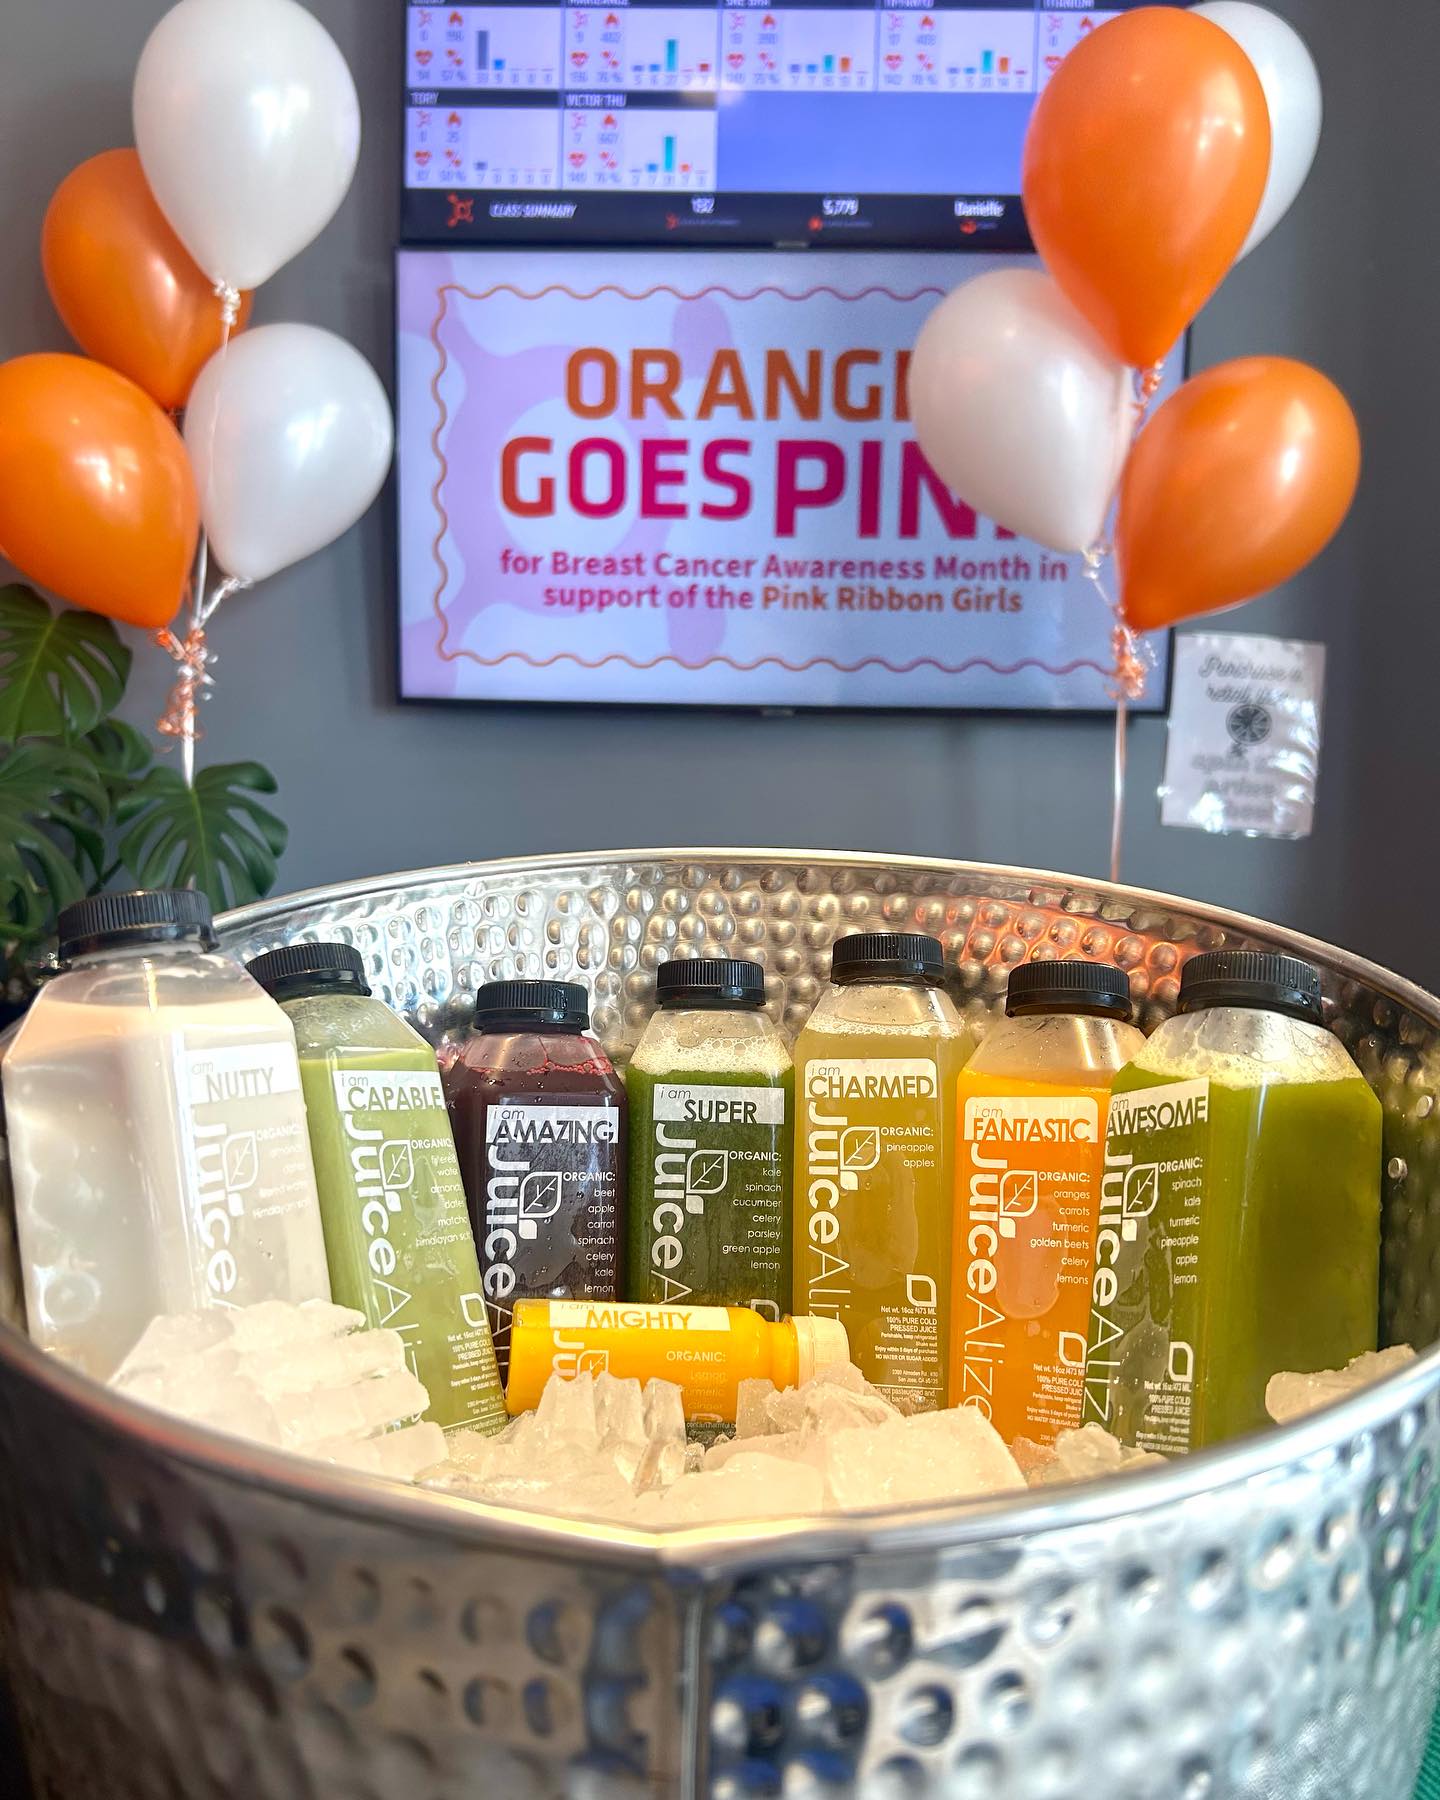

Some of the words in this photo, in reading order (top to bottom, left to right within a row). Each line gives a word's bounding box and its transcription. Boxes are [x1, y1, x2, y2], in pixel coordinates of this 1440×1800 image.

[501, 436, 752, 521] GOES
[774, 440, 1016, 539] PIN
[500, 549, 542, 575] for
[551, 551, 645, 577] Breast
[655, 553, 755, 579] Cancer
[763, 554, 924, 580] Awareness
[934, 555, 1031, 581] Month
[1039, 555, 1068, 581] in
[543, 585, 658, 615] support
[667, 585, 697, 610] of
[705, 586, 752, 610] the
[762, 586, 828, 611] Pink
[837, 587, 944, 612] Ribbon
[953, 588, 1023, 612] Girls
[818, 1066, 840, 1076] am
[206, 1066, 274, 1103] NUTTY
[349, 1075, 369, 1087] am
[808, 1076, 934, 1098] CHARMED
[348, 1086, 443, 1112] CAPABLE
[668, 1089, 691, 1099] am
[501, 1109, 525, 1120] am
[684, 1099, 757, 1123] SUPER
[982, 1107, 1003, 1118] am
[1107, 1096, 1206, 1137] AWESOME
[494, 1120, 613, 1143] AMAZING
[880, 1127, 934, 1136] ORGANIC:
[973, 1118, 1090, 1142] FANTASTIC
[886, 1143, 934, 1152] pineapple
[729, 1150, 782, 1162] ORGANIC:
[903, 1159, 935, 1168] apples
[1159, 1157, 1203, 1174] ORGANIC:
[563, 1171, 616, 1182] ORGANIC:
[763, 1167, 782, 1177] kale
[1038, 1171, 1090, 1183] ORGANIC:
[745, 1183, 782, 1193] spinach
[1172, 1177, 1202, 1191] spinach
[593, 1189, 615, 1197] beet
[1054, 1190, 1090, 1200] oranges
[733, 1198, 782, 1208] cucumber
[1184, 1196, 1200, 1207] kale
[588, 1204, 615, 1215] apple
[1059, 1207, 1090, 1216] carrots
[587, 1219, 615, 1229] carrot
[752, 1214, 781, 1225] celery
[1169, 1214, 1200, 1227] turmeric
[1052, 1221, 1089, 1233] turmeric
[748, 1229, 781, 1240] parsley
[577, 1235, 615, 1247] spinach
[1030, 1236, 1062, 1248] golden
[1064, 1238, 1089, 1249] beets
[1161, 1233, 1199, 1249] pineapple
[722, 1244, 750, 1254] green
[753, 1244, 780, 1256] apple
[586, 1251, 614, 1262] celery
[1061, 1256, 1089, 1268] celery
[1176, 1253, 1198, 1267] apple
[750, 1259, 780, 1270] lemon
[594, 1267, 614, 1277] kale
[1056, 1273, 1089, 1285] lemons
[1174, 1272, 1197, 1284] lemon
[584, 1283, 614, 1293] lemon
[586, 1310, 692, 1329] MIGHTY
[902, 1317, 918, 1325] PURE
[919, 1318, 937, 1326] COLD
[889, 1324, 918, 1332] PRESSED
[666, 1351, 726, 1362] ORGANIC:
[1036, 1375, 1051, 1383] 100%
[1052, 1376, 1068, 1385] PURE
[1041, 1384, 1068, 1394] PRESSED
[1175, 1395, 1191, 1406] COLD
[1151, 1404, 1173, 1414] PRESSED
